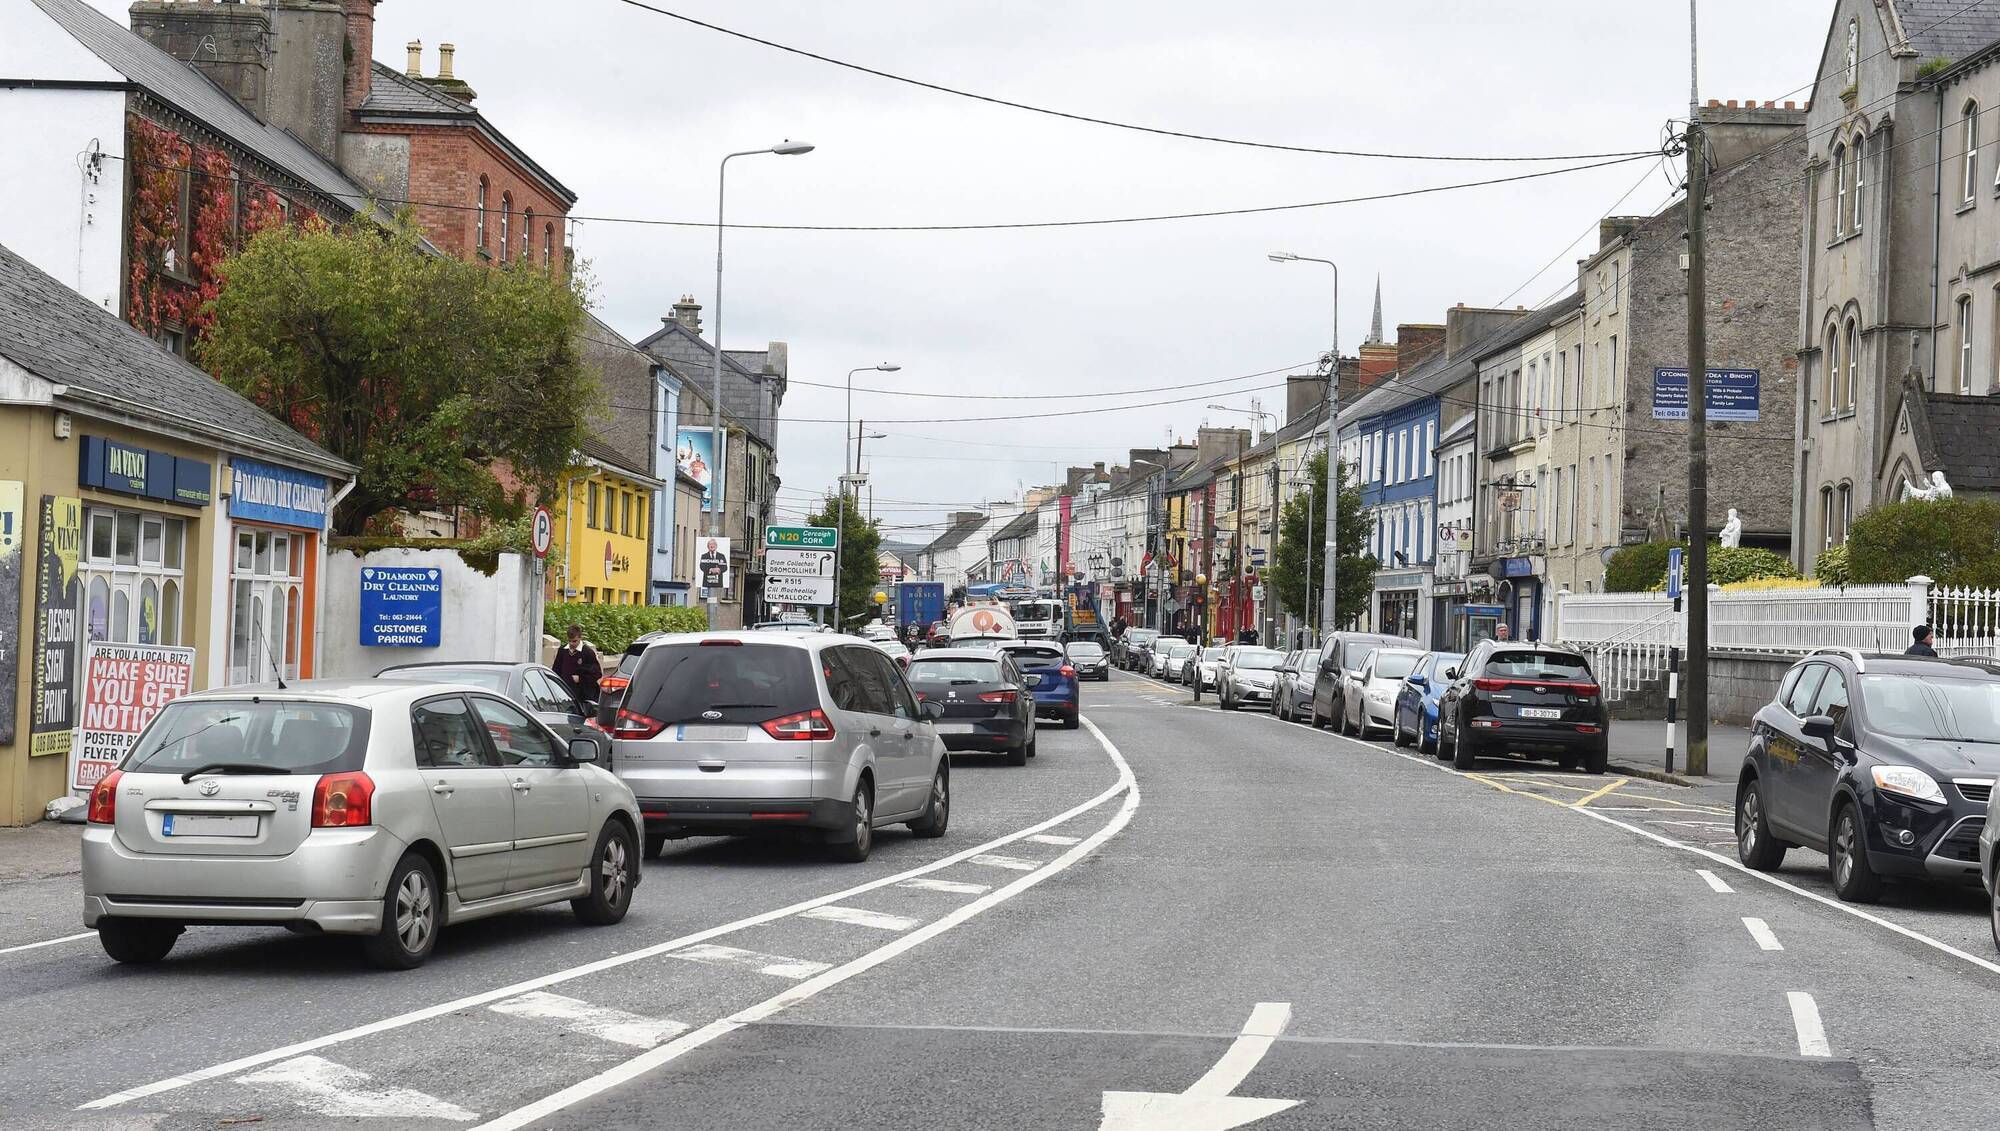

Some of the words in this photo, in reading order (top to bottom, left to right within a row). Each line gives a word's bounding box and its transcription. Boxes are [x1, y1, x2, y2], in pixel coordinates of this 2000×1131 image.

[1661, 371, 1689, 379] O'CONNO
[110, 447, 121, 474] DA
[121, 449, 146, 480] VINCI
[242, 472, 277, 507] DIAMOND
[277, 480, 293, 509] DRY
[292, 483, 325, 515] CLEANING
[66, 503, 77, 528] DA
[43, 503, 53, 558] VISION
[57, 527, 80, 551] VINCI
[802, 530, 831, 539] Corcaigh
[377, 571, 426, 581] DIAMOND
[769, 566, 817, 574] DROMCOLLIHER
[41, 562, 50, 604] WITH
[363, 581, 385, 591] DRY
[388, 581, 440, 592] CLEANING
[382, 593, 420, 601] LAUNDRY
[767, 593, 813, 601] KILMALLOCK
[47, 608, 75, 643] DESIGN
[373, 624, 428, 633] CUSTOMER
[377, 635, 423, 644] PARKING
[36, 608, 48, 725] COMMUNICATE
[45, 649, 65, 684] SIGN
[94, 647, 112, 659] ARE
[114, 649, 131, 661] YOU
[132, 650, 139, 661] A
[141, 651, 167, 664] LOCAL
[169, 654, 189, 665] BIZ?
[92, 659, 140, 681] MAKE
[143, 663, 188, 684] SURE
[91, 677, 136, 706] YOU
[141, 682, 186, 709] GET
[43, 688, 68, 724] PRINT
[86, 703, 160, 732] NOTIC
[84, 732, 124, 747] POSTER
[83, 746, 119, 760] FLYER
[80, 763, 107, 780] GRAB
